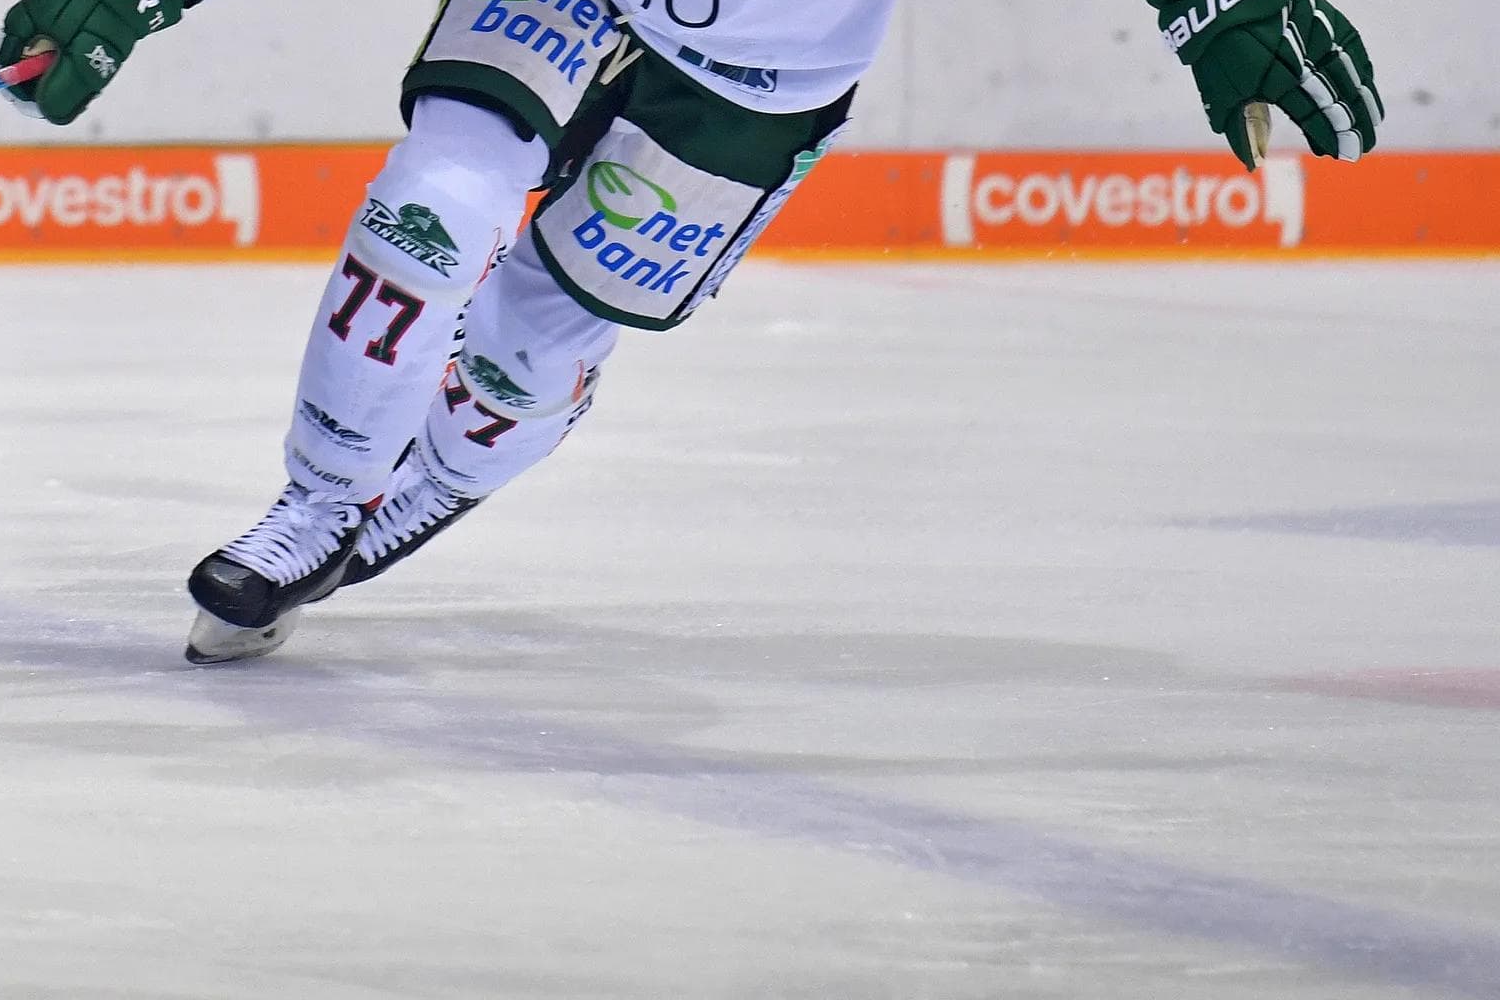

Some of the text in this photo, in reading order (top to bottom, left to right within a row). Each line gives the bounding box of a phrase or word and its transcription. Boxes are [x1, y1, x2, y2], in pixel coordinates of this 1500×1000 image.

[636, 209, 725, 258] net
[974, 167, 1266, 224] covestro
[359, 197, 461, 279] PANTHER
[573, 210, 692, 295] bank
[329, 252, 426, 367] 77
